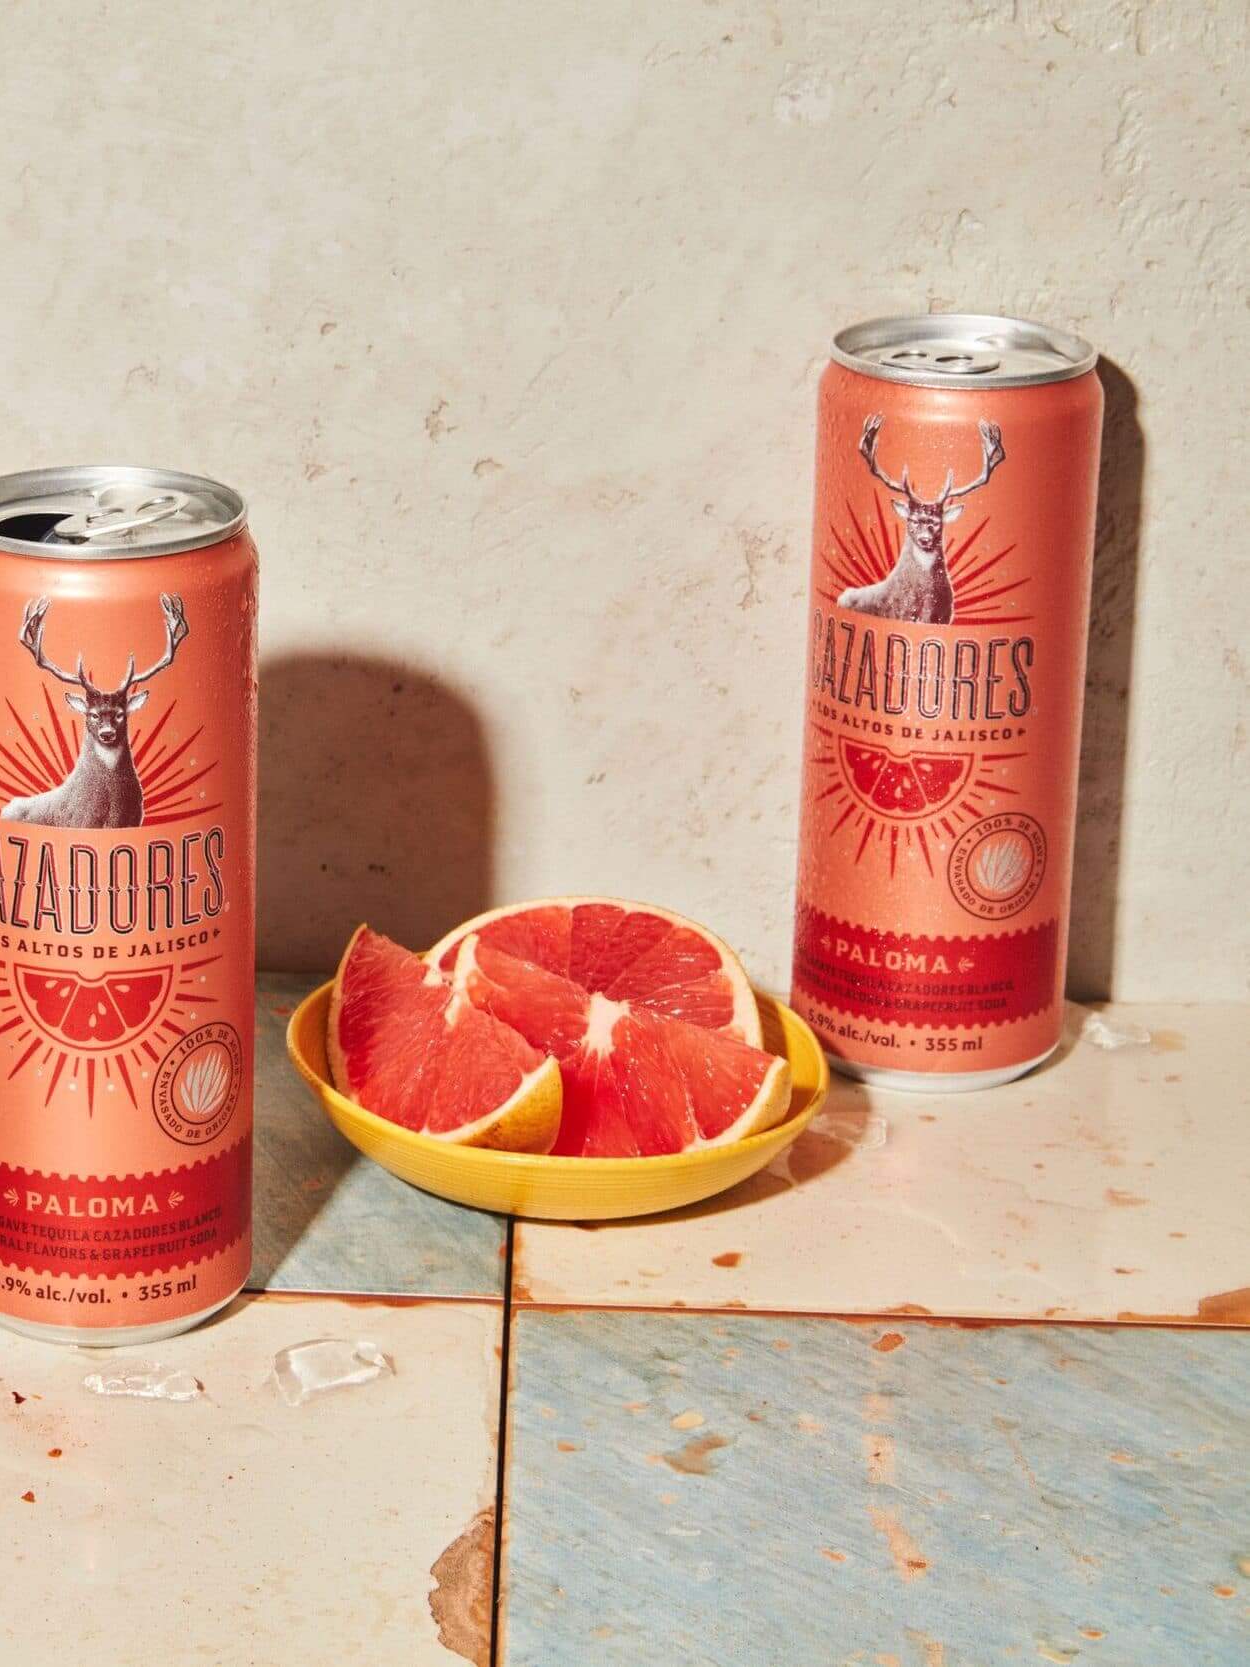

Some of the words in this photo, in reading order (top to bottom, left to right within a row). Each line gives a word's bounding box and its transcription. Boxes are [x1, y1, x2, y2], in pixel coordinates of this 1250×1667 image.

[813, 608, 1035, 720] CAZADORES
[816, 705, 838, 721] LOS
[841, 714, 894, 736] ALTOS
[901, 727, 923, 740] DE
[932, 728, 1012, 742] JALISCO
[975, 817, 1012, 837] 100%
[954, 847, 976, 906] ENVASADO
[979, 903, 994, 914] DE
[17, 939, 83, 959] ALTOS
[93, 946, 119, 959] DE
[126, 932, 209, 958] JALISCO
[836, 938, 951, 975] PALOMA
[179, 1028, 213, 1056] 100%
[218, 1029, 230, 1040] DE
[807, 1008, 837, 1032] 5.9%
[837, 1023, 901, 1049] alc./vol.
[925, 1037, 958, 1052] 355
[961, 1036, 983, 1051] ml
[158, 1070, 183, 1133] ENVASADO
[185, 1128, 201, 1139] DE
[25, 1189, 160, 1219] PALOMA
[26, 1241, 86, 1260] FLAVORS
[102, 1238, 187, 1261] GRAPEFRUIT
[190, 1227, 217, 1248] SODA
[30, 1223, 89, 1241] TEQUILA
[93, 1221, 176, 1242] CAZADORES
[36, 1282, 112, 1304] alc./vol.
[138, 1282, 173, 1302] 355
[176, 1274, 198, 1294] ml
